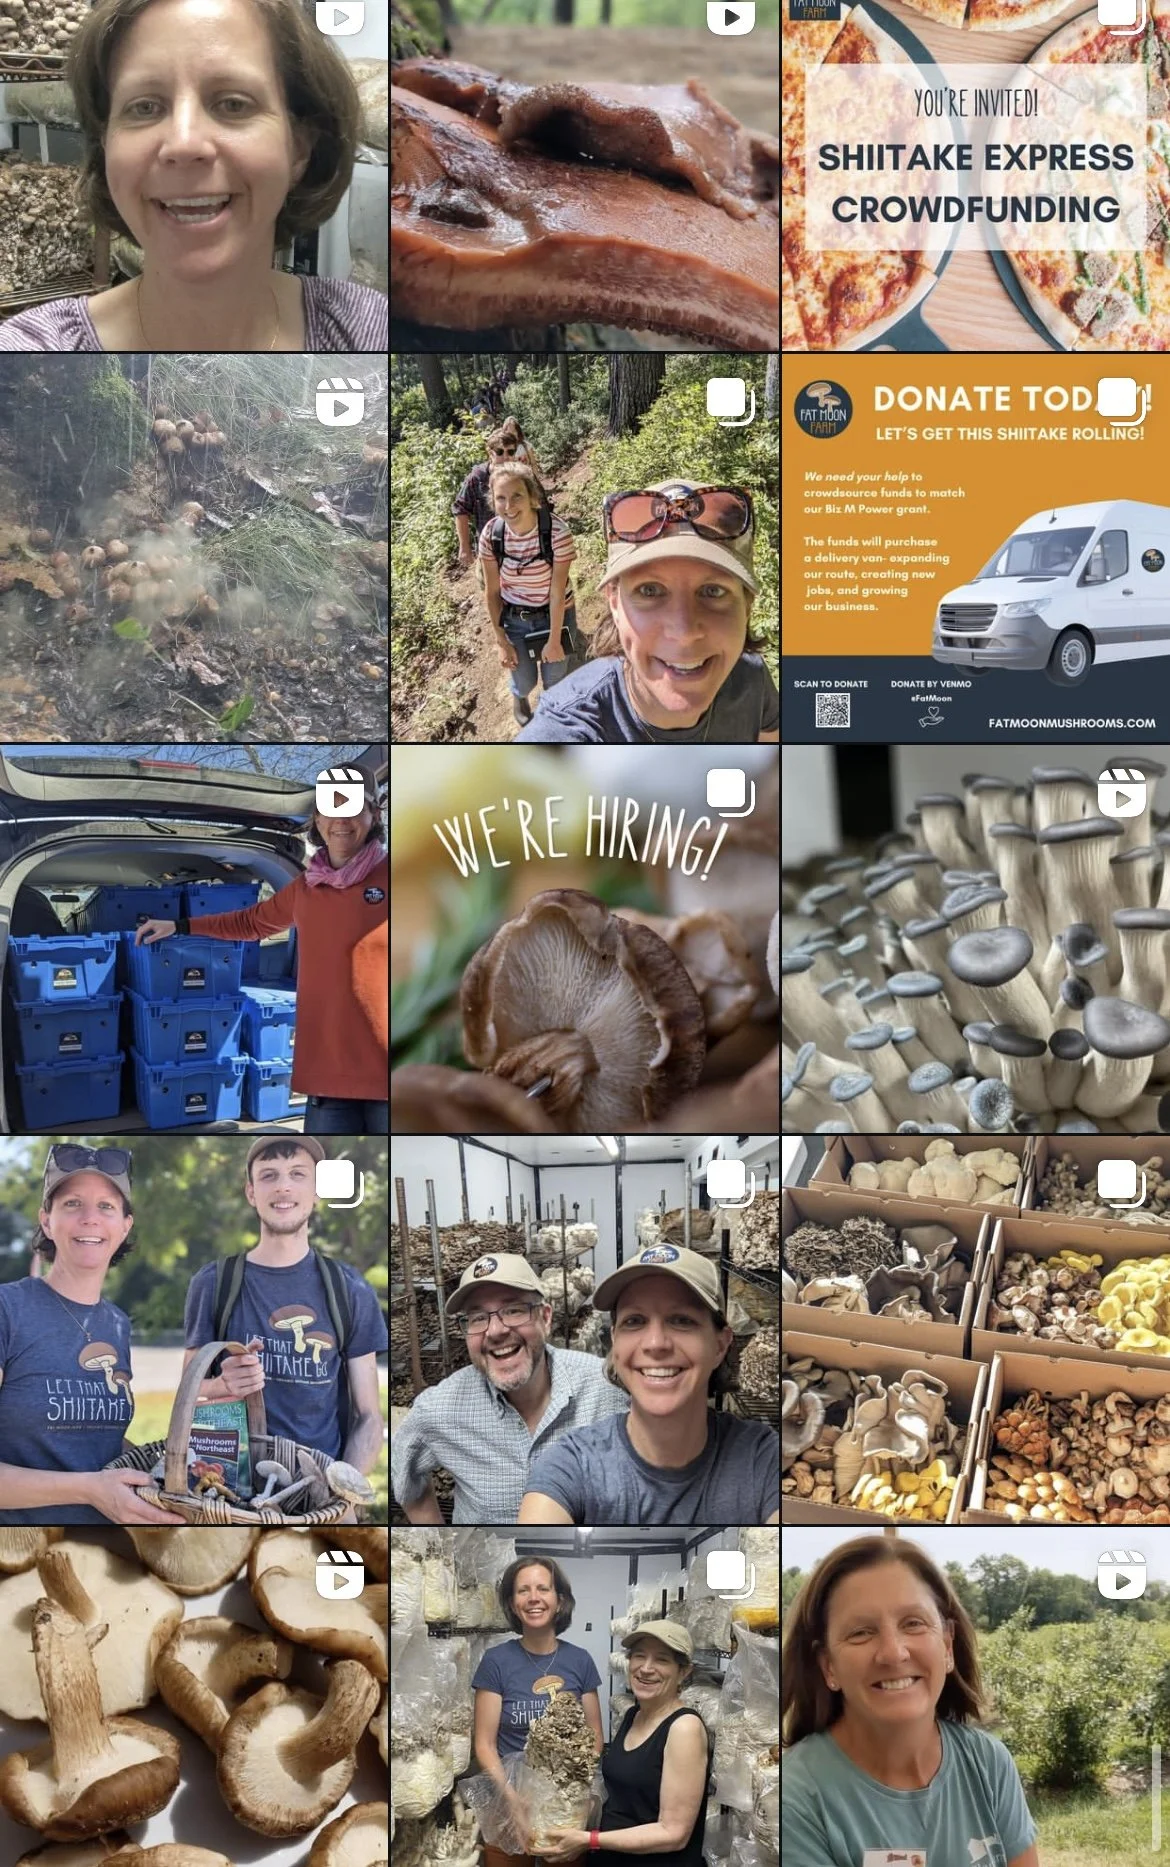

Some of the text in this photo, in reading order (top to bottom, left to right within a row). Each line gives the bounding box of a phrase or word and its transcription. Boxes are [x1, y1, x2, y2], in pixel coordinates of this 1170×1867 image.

[803, 7, 827, 18] FARM
[914, 87, 1039, 117] YOU'RE INVITED!
[818, 143, 1135, 172] SHIITAKE EXPRESS
[831, 195, 1121, 223] CROWDFUNDING
[874, 384, 1152, 412] DONATE TOD!
[800, 408, 848, 421] FAT MOON
[810, 421, 837, 433] FARM
[876, 426, 1145, 441] LET'S GET THIS SHIITAKE ROLLING!
[804, 470, 923, 485] We need your help to
[803, 486, 966, 498] crowdsource funds to match
[803, 503, 931, 517] our Biz M Power grant.
[803, 535, 938, 549] The funds will purchase
[803, 551, 950, 566] a delivery van- expanding
[803, 568, 936, 582] our route, creating new
[806, 584, 909, 598] jobs, and growing
[803, 600, 879, 611] our business.
[793, 680, 869, 688] SCAN TO DONATE
[890, 680, 972, 688] DONATE BY VENMO
[988, 717, 1157, 729] FATMOONMUSHROOMS.COM
[266, 1338, 293, 1354] THAT
[255, 1350, 313, 1378] HIITAKE
[46, 1379, 106, 1396] LET THAT
[47, 1396, 126, 1421] SHIITAKE
[189, 1436, 236, 1446] Mushrooms
[195, 1444, 236, 1453] Northeast
[512, 1700, 527, 1710] LET
